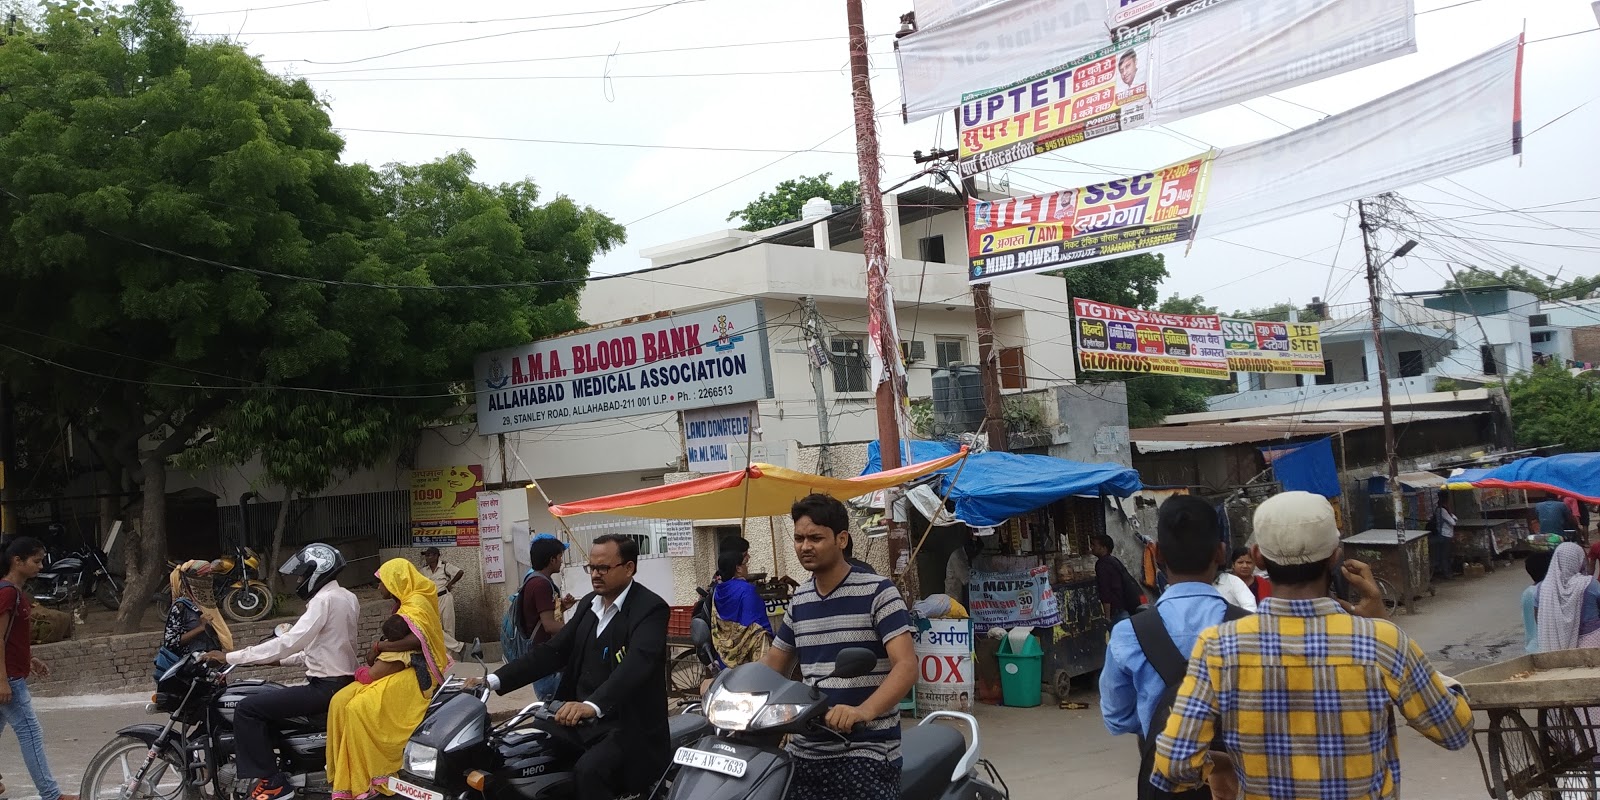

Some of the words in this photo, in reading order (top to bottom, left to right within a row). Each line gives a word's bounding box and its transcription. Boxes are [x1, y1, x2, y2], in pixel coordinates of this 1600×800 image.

[1123, 2, 1155, 18] Grammar
[1077, 71, 1086, 79] 12
[1087, 64, 1102, 77] बजे
[1103, 58, 1112, 68] से
[1081, 76, 1096, 88] बजे
[1096, 71, 1113, 83] तक
[963, 70, 1073, 127] UPTET
[1076, 99, 1084, 108] 10
[1086, 92, 1101, 104] बजे
[1102, 88, 1111, 98] से
[1079, 106, 1093, 117] बजे
[1095, 101, 1112, 112] तक
[962, 118, 1010, 152] सुपर
[1014, 99, 1072, 138] TET
[979, 141, 1036, 171] Education
[1084, 172, 1155, 205] SSC
[1160, 180, 1180, 207] 5
[991, 191, 1059, 228] TET
[1075, 203, 1146, 233] दारोगा
[1156, 205, 1179, 220] 11:00
[981, 234, 994, 254] 2
[996, 234, 1025, 249] अगस्त
[1027, 226, 1036, 245] 7
[1037, 225, 1057, 243] AM
[972, 259, 985, 267] THE
[985, 254, 1015, 274] MIND
[1017, 245, 1060, 269] POWER
[712, 324, 719, 333] A
[727, 321, 735, 330] A
[1081, 320, 1104, 337] हिन्दी
[1136, 327, 1161, 344] भूगोल
[1221, 321, 1255, 342] SSC
[1293, 325, 1312, 337] TET
[1163, 329, 1188, 345] इतिहास
[1291, 339, 1318, 351] S-TET
[511, 350, 567, 385] A.M.A.
[572, 335, 637, 375] BLOOD
[641, 323, 703, 363] BANK
[1190, 343, 1198, 356] 6
[1080, 351, 1152, 372] GLORIOUS
[1152, 364, 1180, 373] WORLD
[1227, 357, 1274, 372] GLORIOUS
[488, 383, 565, 412] ALLAHABAD
[572, 373, 636, 399] MEDICAL
[640, 353, 747, 390] ASSOCIATION
[502, 415, 513, 427] 29,
[513, 409, 546, 425] STANLEY
[547, 406, 571, 421] ROAD,
[572, 399, 636, 417] ALLAHABAD-211
[637, 396, 651, 408] 001
[652, 393, 668, 405] U.P.
[698, 384, 733, 400] 2266513
[685, 421, 707, 440] LAND
[707, 417, 742, 438] DONATED
[743, 416, 751, 435] B
[710, 444, 728, 461] AHUJ
[413, 488, 443, 501] 1090
[983, 579, 1034, 592] MATHS
[1000, 599, 1017, 609] SIR
[1018, 595, 1033, 605] 30
[928, 626, 969, 646] अर्पण
[917, 654, 965, 683] OX
[712, 743, 737, 754] HONDA
[522, 764, 545, 777] Hero
[677, 749, 695, 764] UP44
[700, 755, 717, 767] AW
[722, 759, 744, 775] 7633
